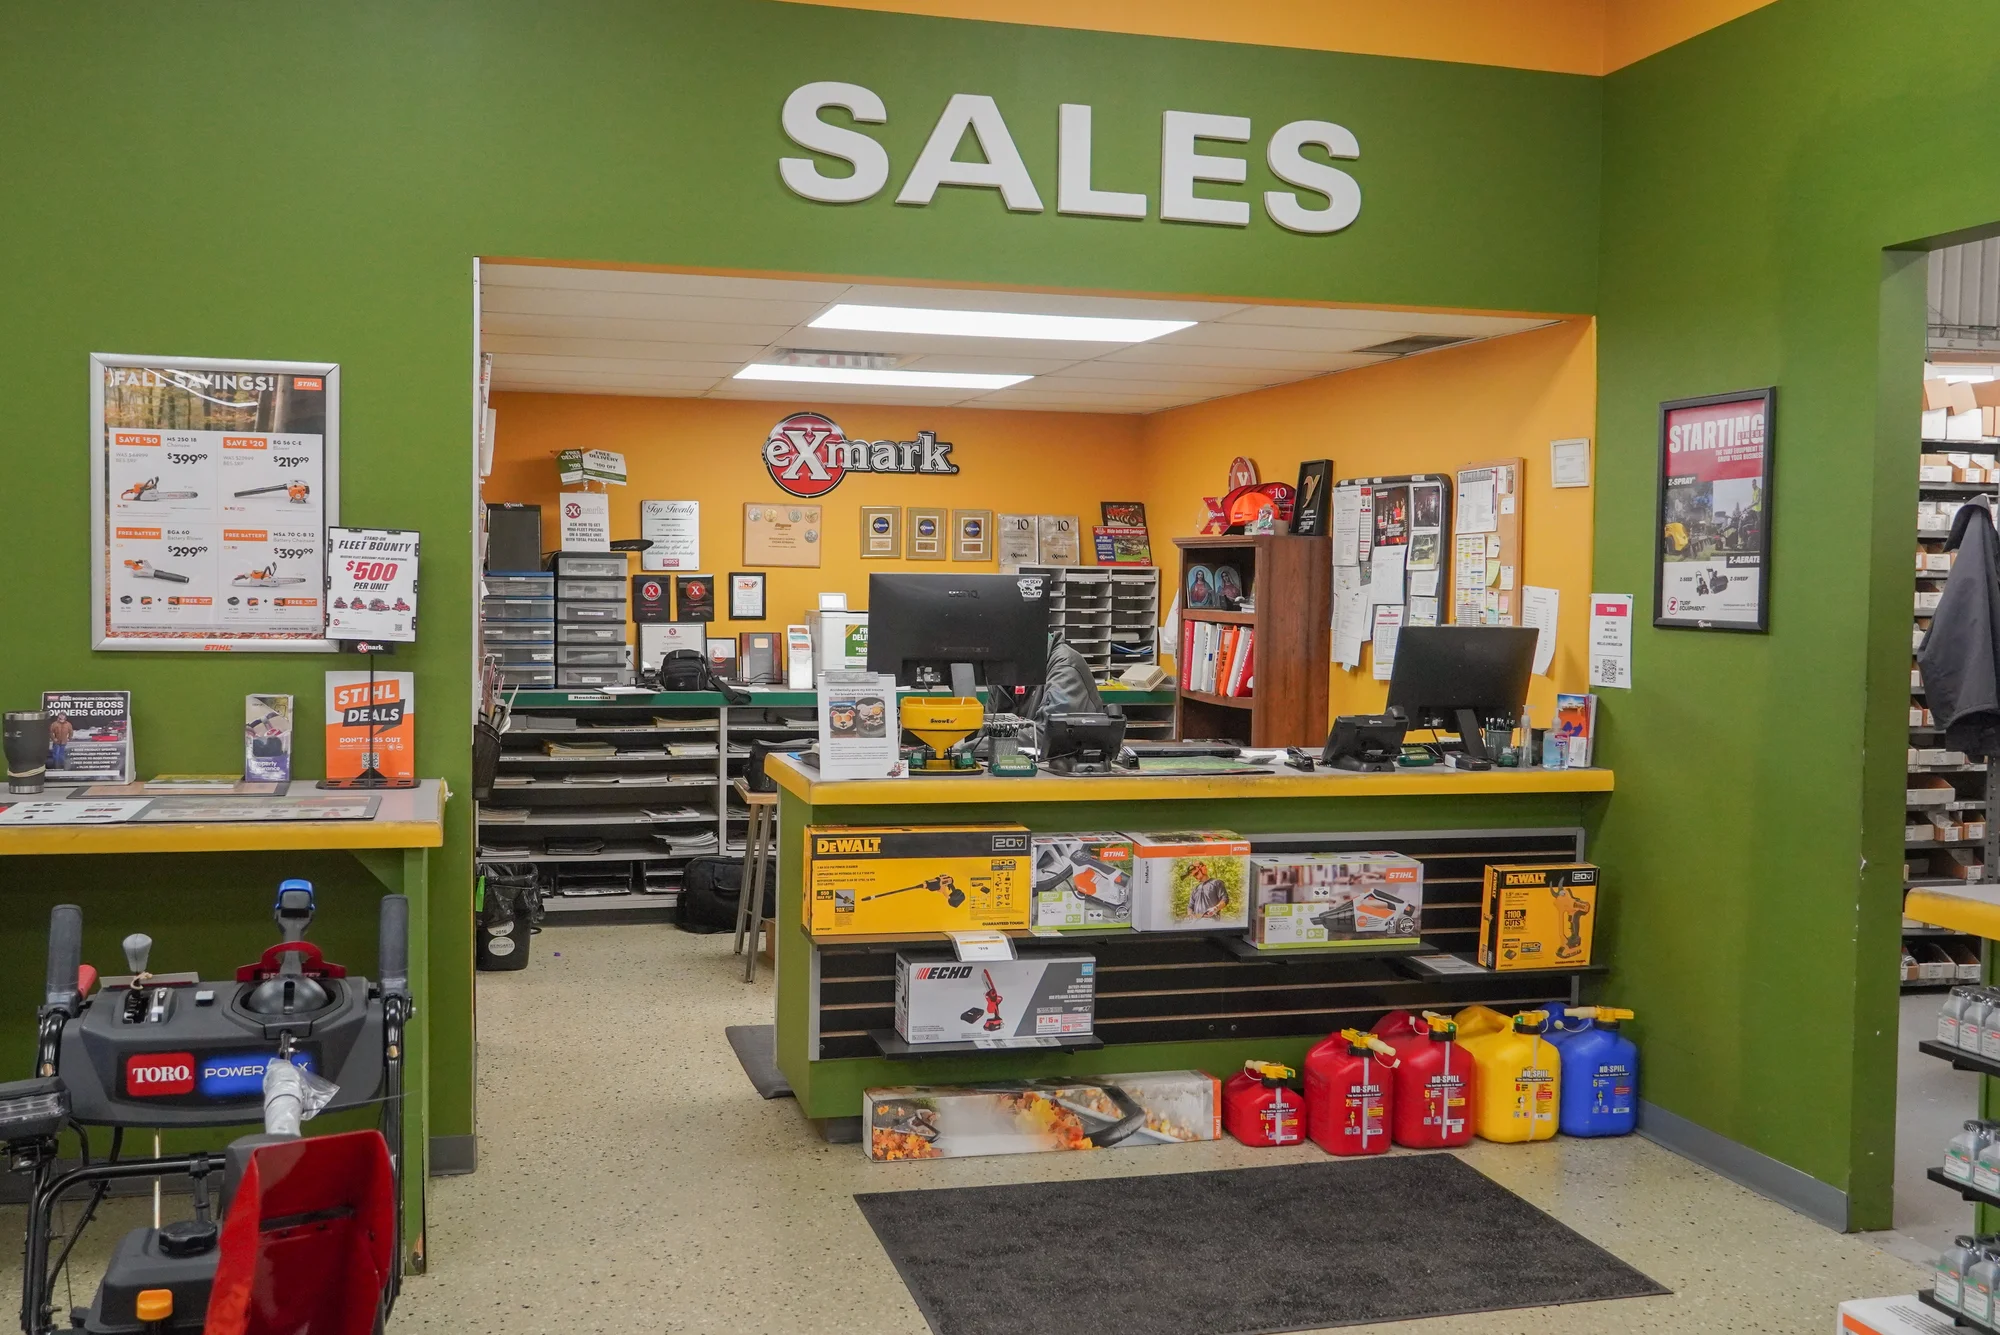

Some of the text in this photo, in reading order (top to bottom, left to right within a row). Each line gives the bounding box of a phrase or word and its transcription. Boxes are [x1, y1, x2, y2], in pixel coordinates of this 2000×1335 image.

[779, 81, 1362, 233] SALES
[114, 370, 275, 392] FALL SAVINGS!
[119, 436, 158, 444] SAVE $50
[1669, 413, 1765, 454] STARTING
[588, 454, 618, 462] DELIVERY
[766, 430, 952, 481] eXmark
[646, 503, 695, 516] Top Twenty
[1016, 518, 1030, 530] 10
[1057, 520, 1070, 532] 10
[338, 540, 412, 553] FLEET BOUNTY
[346, 560, 398, 582] $500
[338, 684, 396, 705] STIHL
[348, 708, 400, 722] DEALS
[995, 838, 1024, 848] 20V
[927, 966, 973, 980] ECHO
[133, 1065, 188, 1083] TORO
[204, 1066, 263, 1078] POWER
[1522, 1070, 1549, 1078] NO-SPILL
[1599, 1065, 1625, 1073] NO-SPILL
[1351, 1084, 1380, 1093] NO-SPILL
[1424, 1090, 1430, 1098] 5
